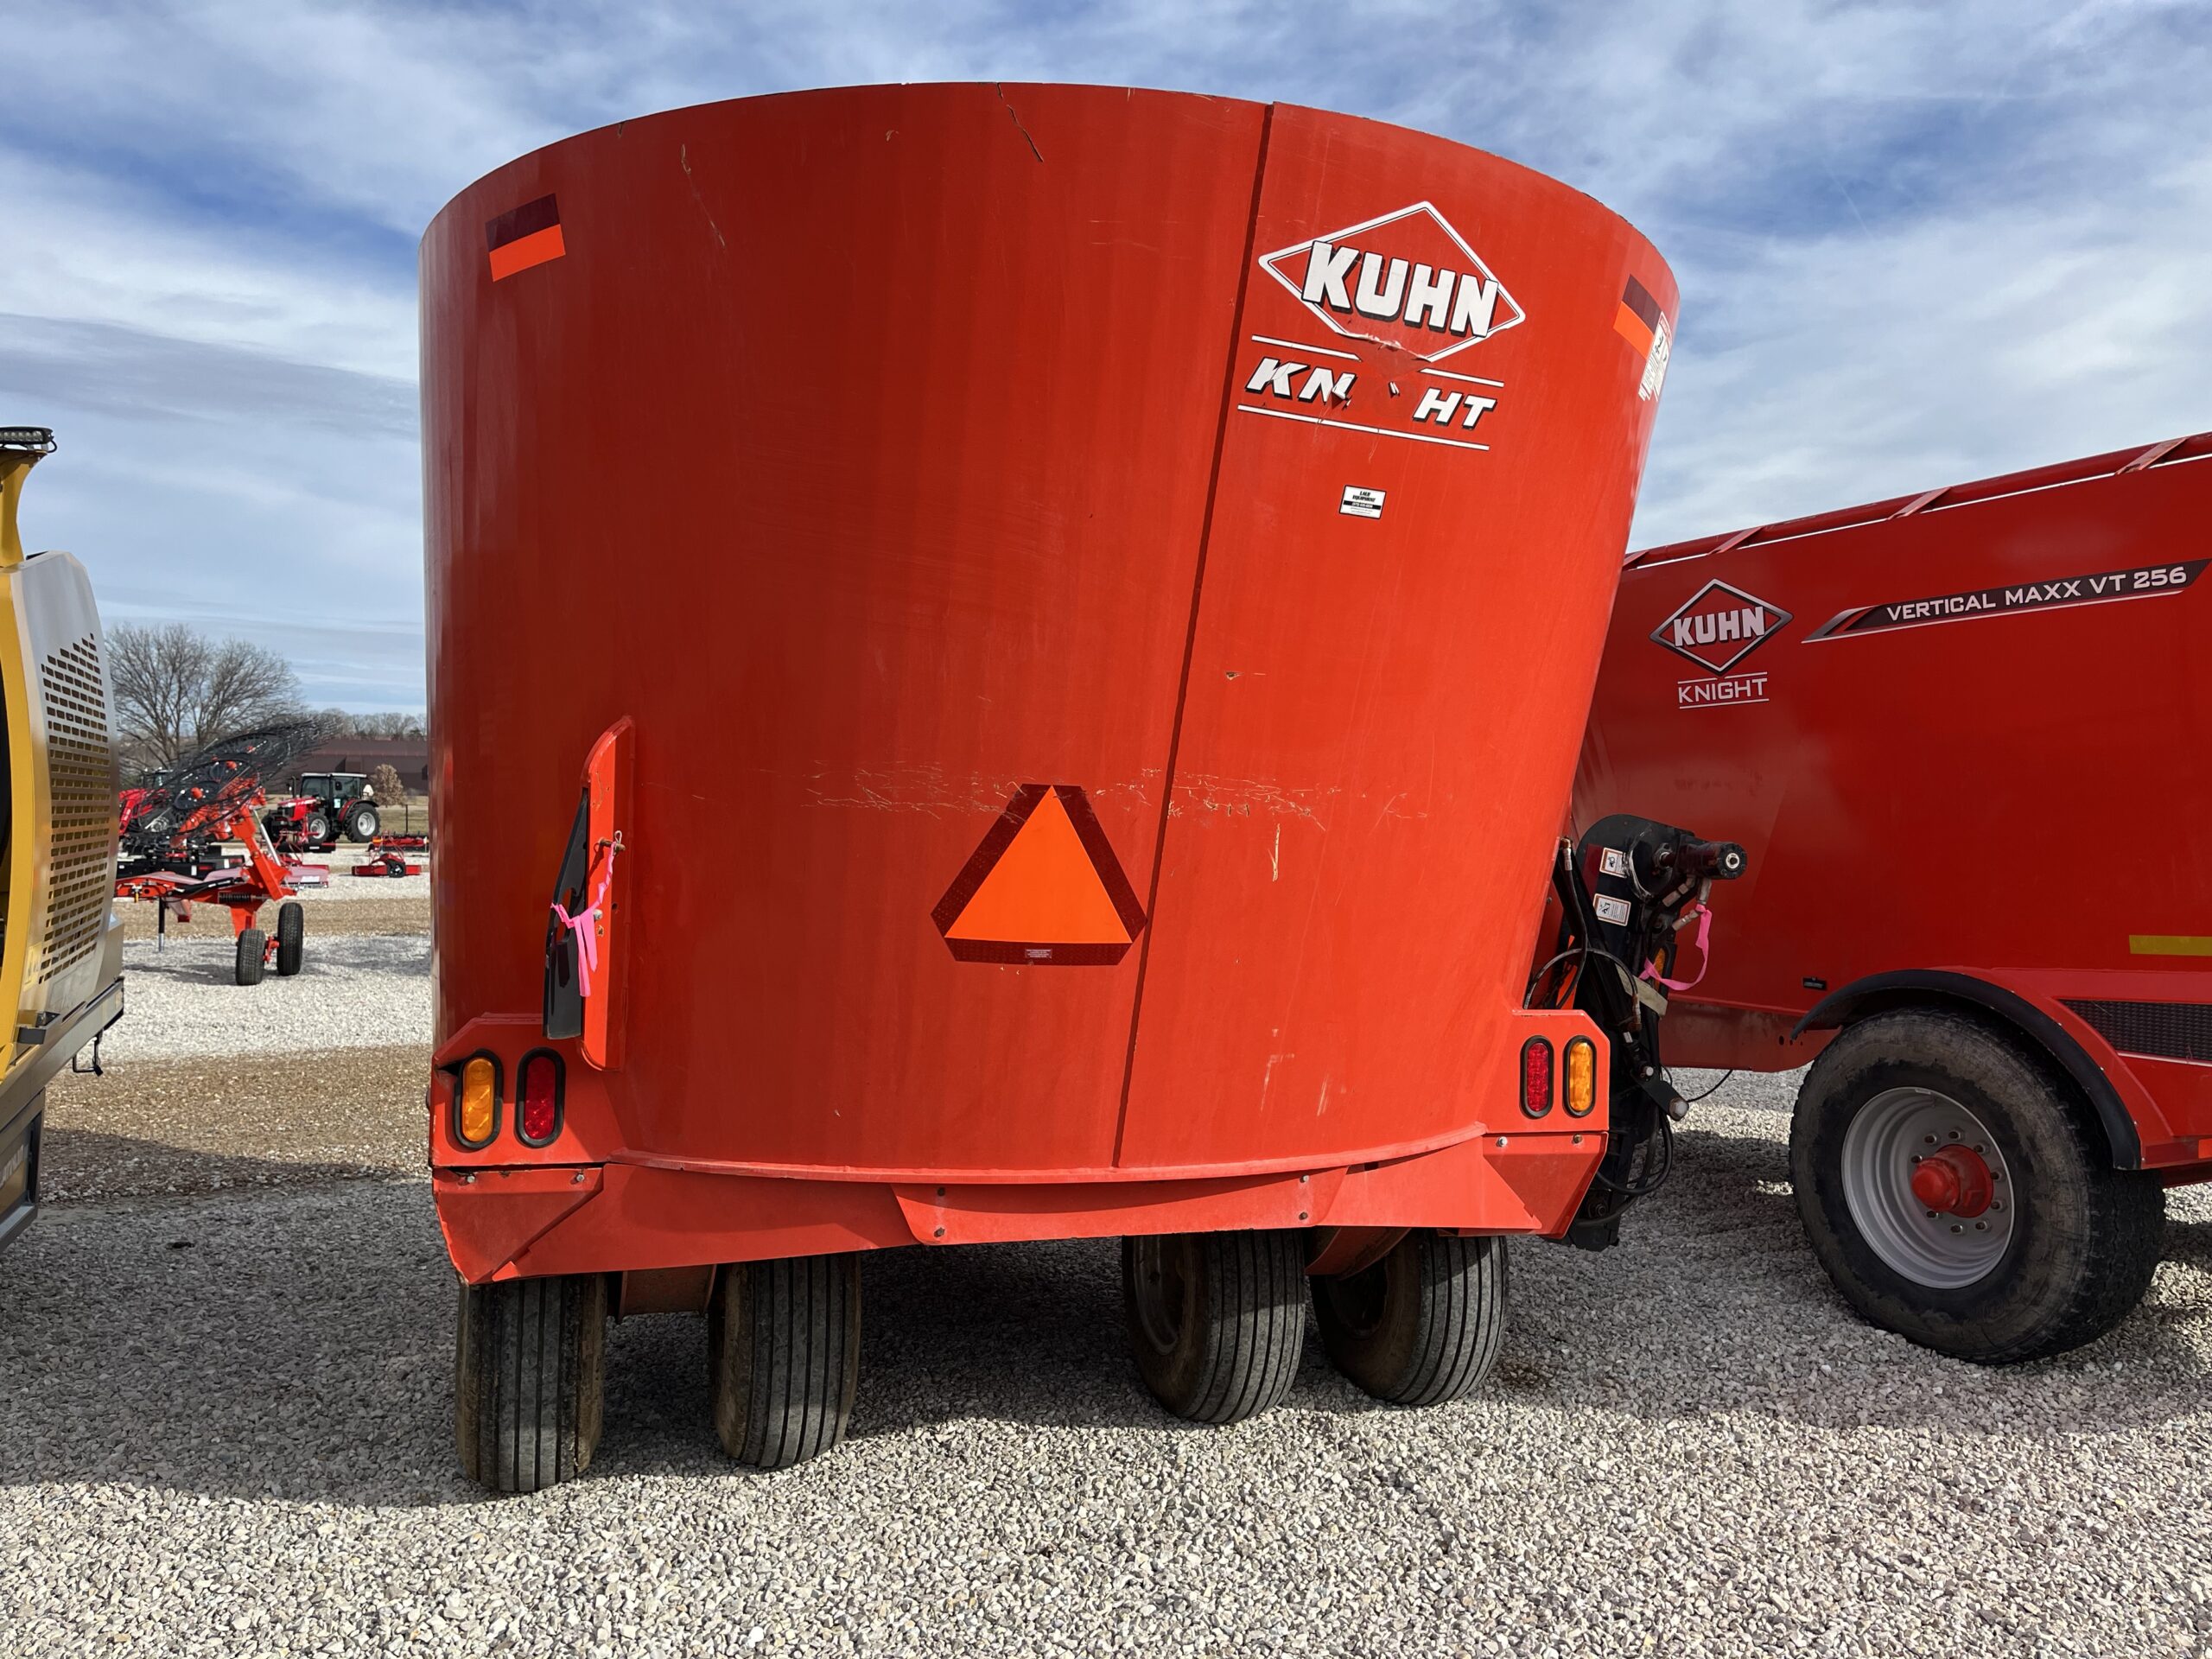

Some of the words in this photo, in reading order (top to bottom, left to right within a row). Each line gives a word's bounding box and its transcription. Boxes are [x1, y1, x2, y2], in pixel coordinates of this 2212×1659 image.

[1301, 240, 1498, 338] KUHN
[1245, 356, 1497, 429] KNHT
[1886, 596, 1996, 621] VERTICAL
[2005, 580, 2082, 606] MAXX
[2089, 574, 2126, 594] VT
[2133, 566, 2187, 589] 256
[1673, 606, 1765, 647] KUHN
[1678, 677, 1768, 703] KNIGHT
